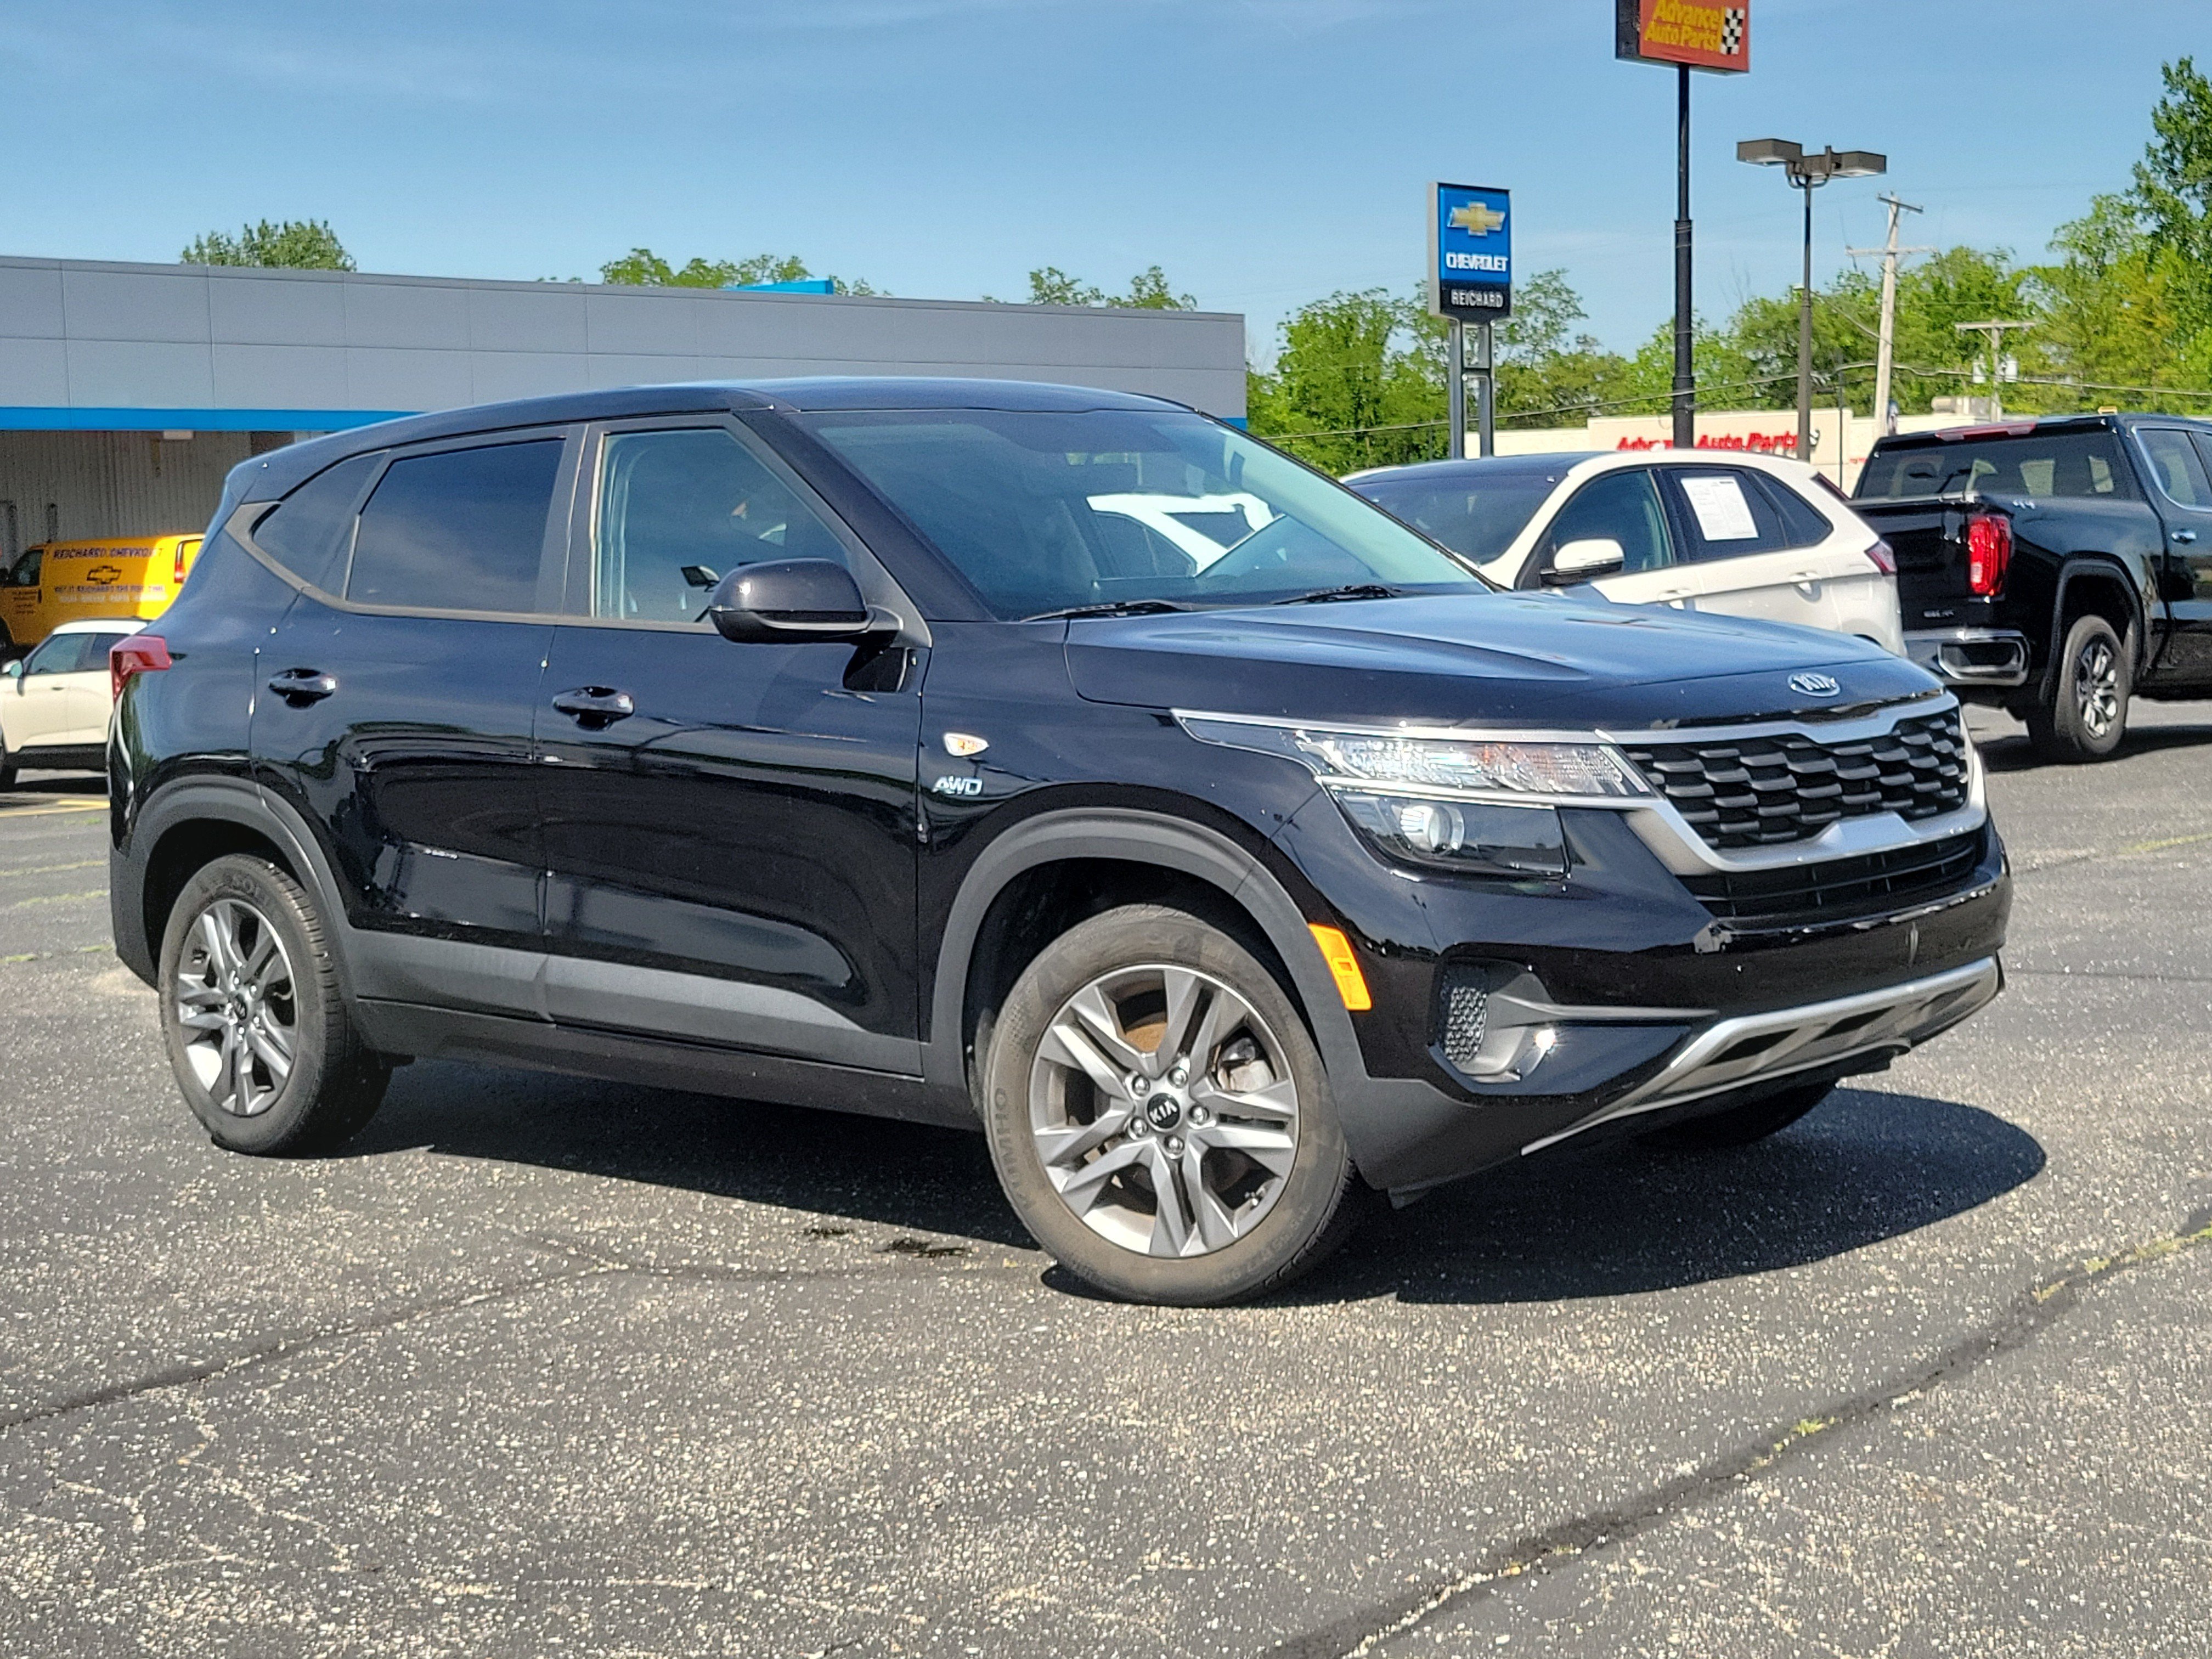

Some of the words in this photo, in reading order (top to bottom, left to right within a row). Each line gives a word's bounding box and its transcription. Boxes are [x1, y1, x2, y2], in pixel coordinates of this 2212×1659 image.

[1644, 21, 1679, 45] Auto
[1446, 252, 1508, 272] CHEVROLET
[1452, 289, 1504, 307] REICHARD
[932, 775, 983, 796] AWD
[1149, 1100, 1178, 1124] KIA
